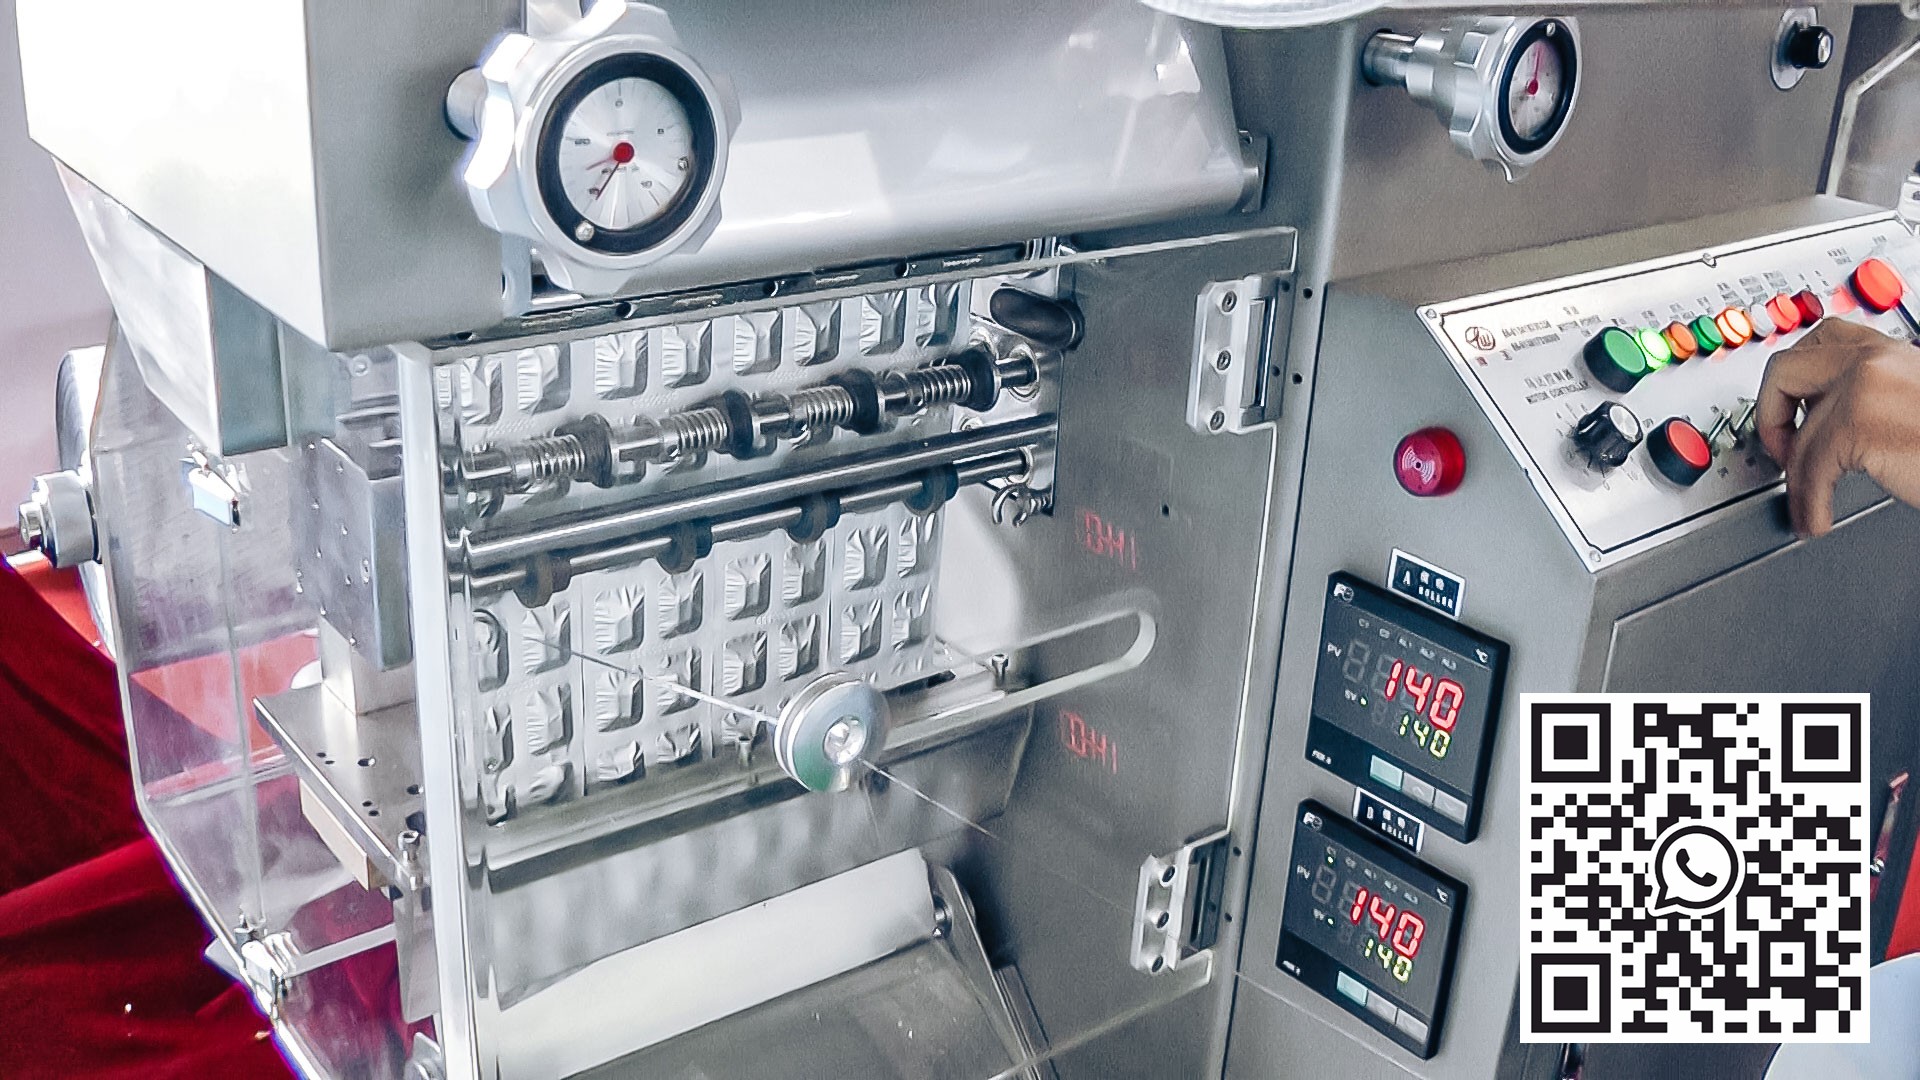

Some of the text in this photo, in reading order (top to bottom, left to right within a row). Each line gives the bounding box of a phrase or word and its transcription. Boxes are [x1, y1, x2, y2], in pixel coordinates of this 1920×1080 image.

[1385, 660, 1463, 730] 140
[1399, 713, 1451, 758] 140
[1351, 887, 1424, 957] 140
[1364, 938, 1412, 981] 140
